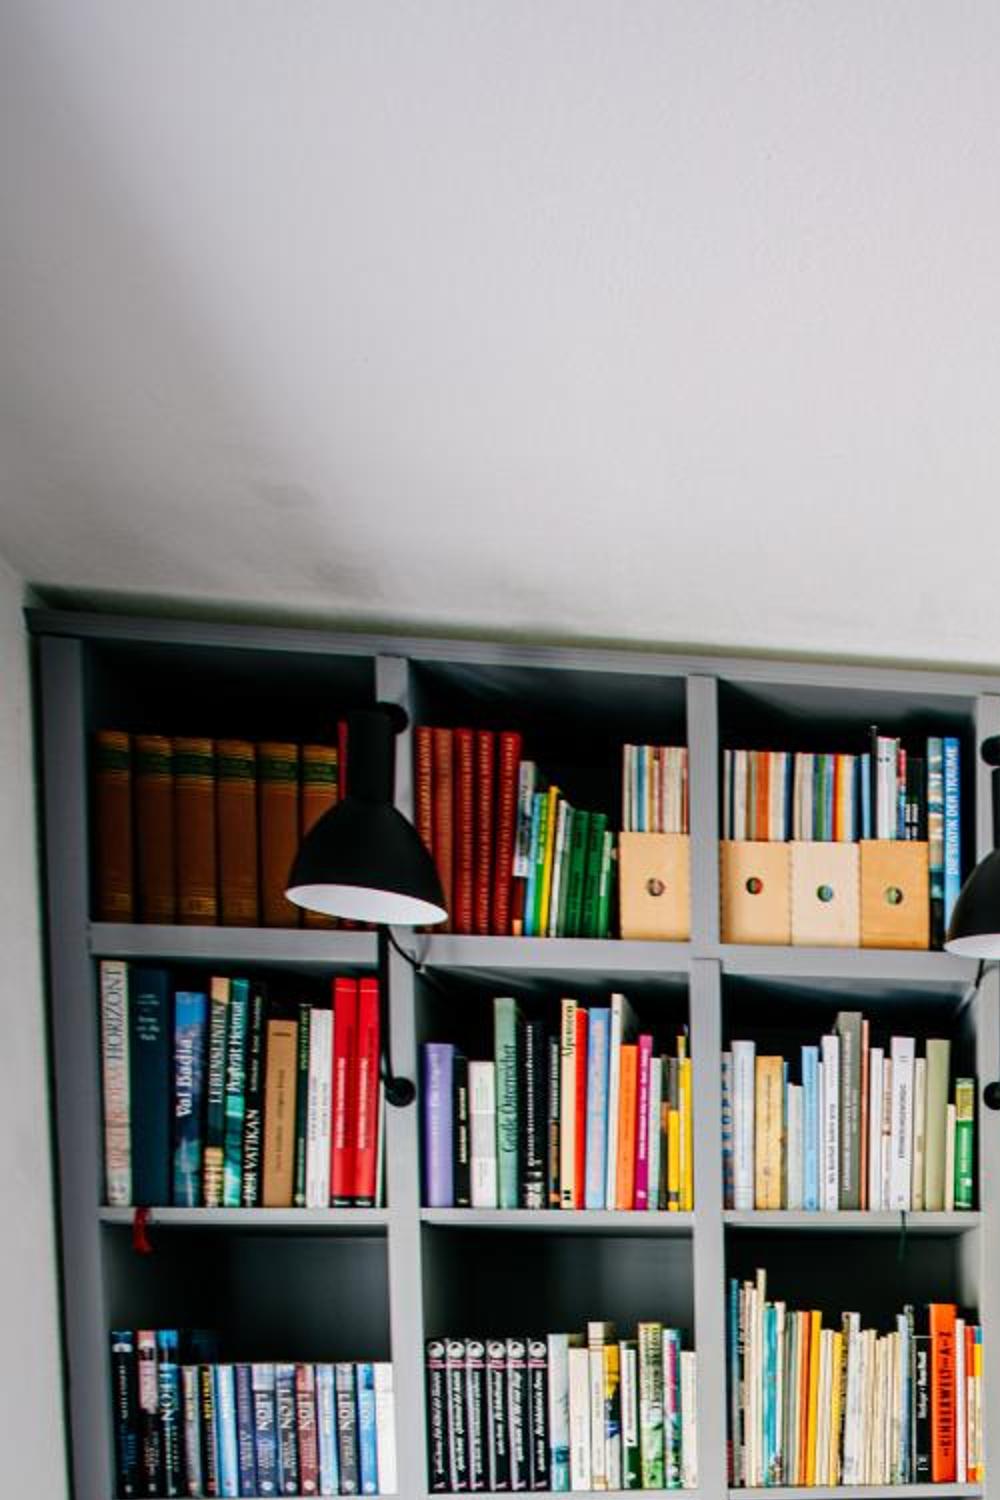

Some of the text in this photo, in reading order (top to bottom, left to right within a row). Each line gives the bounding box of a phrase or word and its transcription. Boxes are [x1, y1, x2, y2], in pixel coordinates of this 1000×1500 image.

[103, 970, 124, 1061] HORIZONT
[174, 1093, 193, 1118] Val
[245, 1108, 260, 1170] VATIKAN
[159, 1373, 178, 1421] LEON
[256, 1393, 273, 1430] LEON
[278, 1389, 295, 1428] LEON
[298, 1393, 315, 1431] LEON
[338, 1393, 354, 1431] LEON
